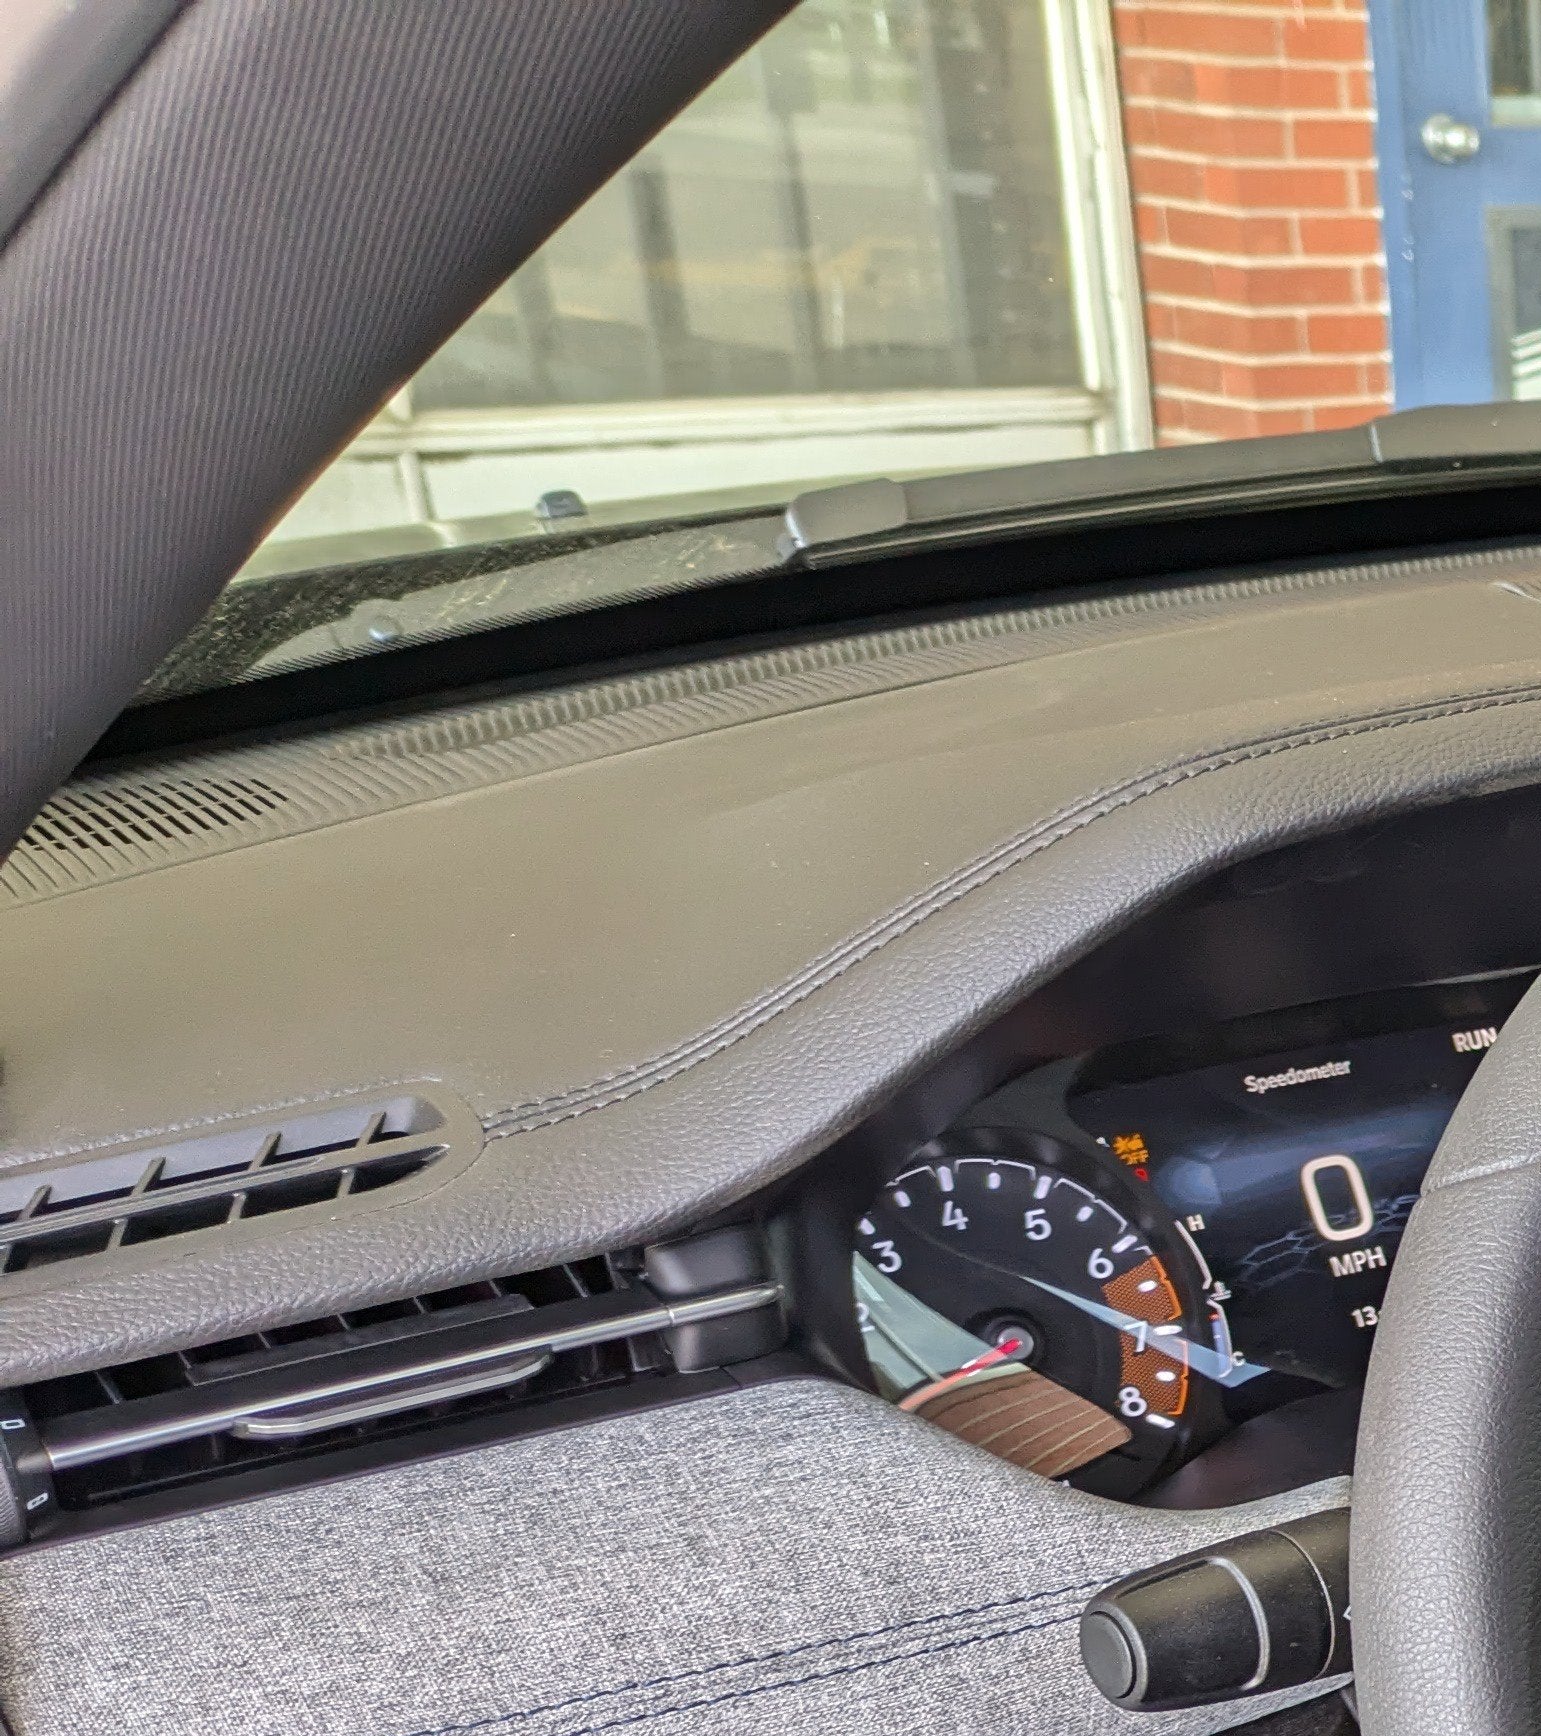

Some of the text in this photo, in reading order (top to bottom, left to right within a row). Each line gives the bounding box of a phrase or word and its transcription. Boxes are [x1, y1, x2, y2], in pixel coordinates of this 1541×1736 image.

[1452, 1026, 1498, 1053] RUN
[1244, 1060, 1351, 1094] Speedometer
[1300, 1154, 1374, 1242] 0
[942, 1201, 969, 1231] 4
[1025, 1208, 1052, 1242] 5
[1187, 1213, 1206, 1232] H
[877, 1241, 903, 1274] 3
[1088, 1248, 1115, 1279] 6
[1328, 1246, 1388, 1278] MPH
[1118, 1386, 1148, 1418] 8
